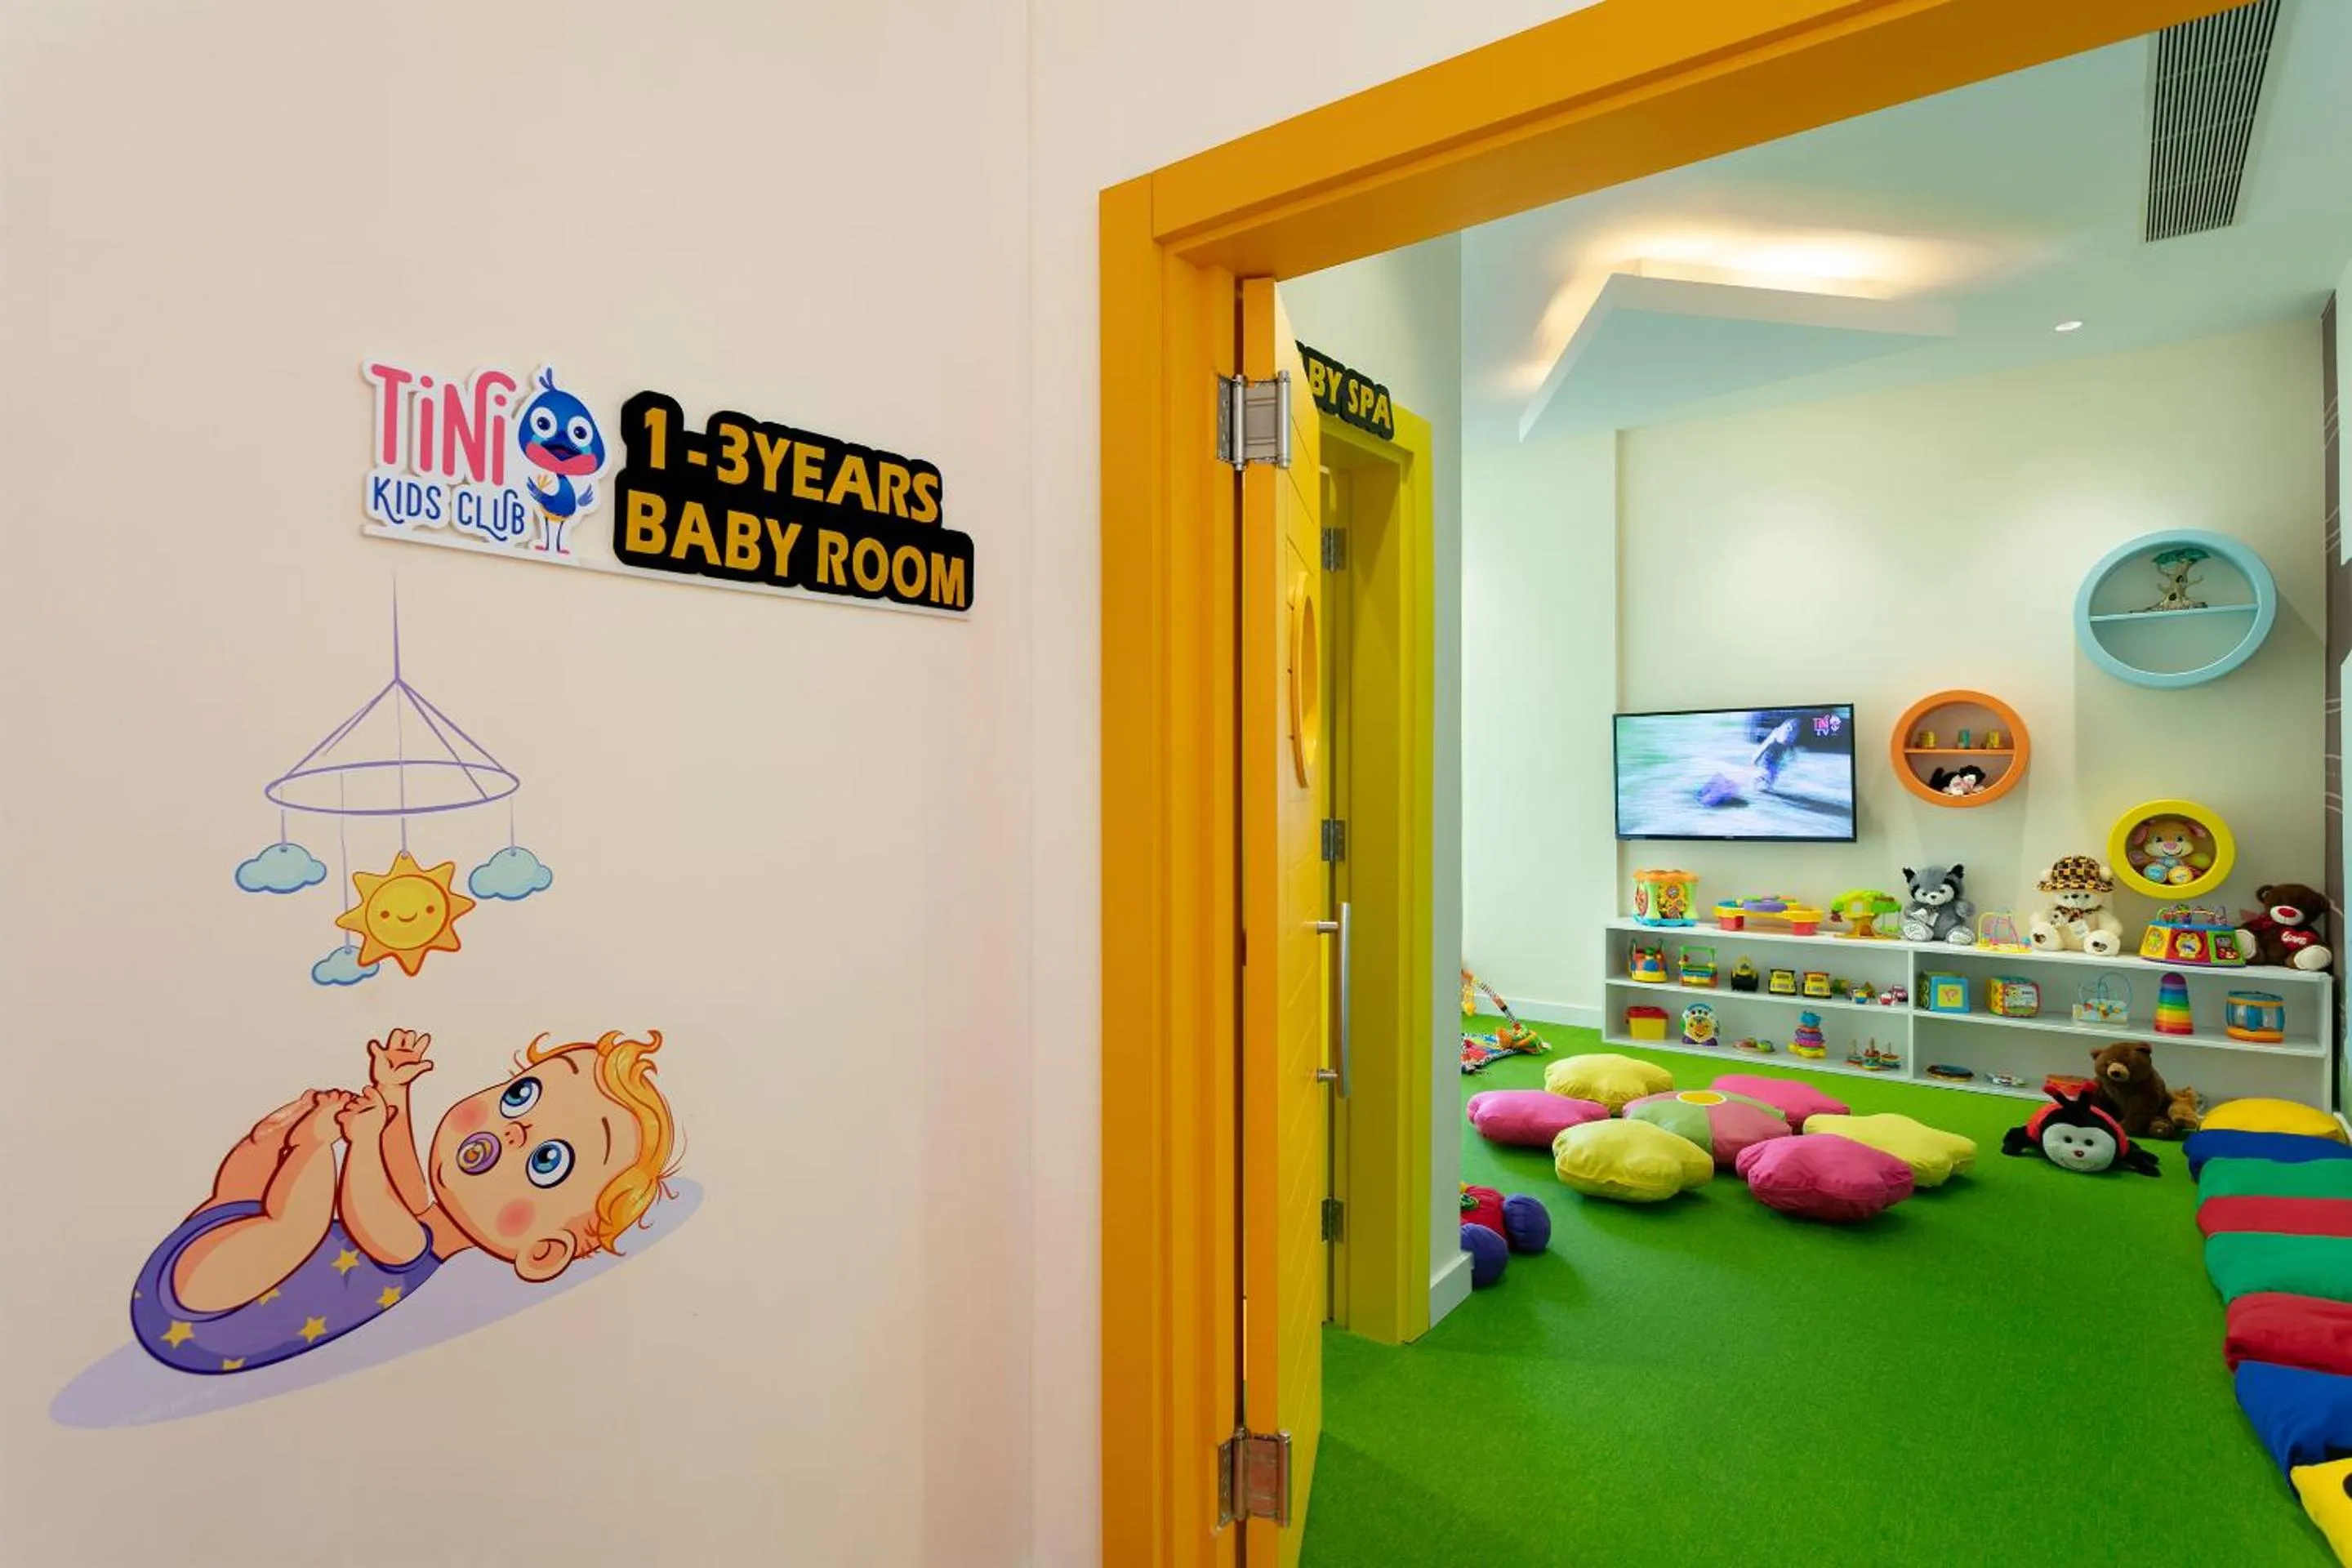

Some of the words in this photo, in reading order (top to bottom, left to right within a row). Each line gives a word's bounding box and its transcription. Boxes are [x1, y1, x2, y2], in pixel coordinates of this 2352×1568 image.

[1348, 379, 1391, 429] SPA
[373, 475, 442, 524] KIDS
[458, 488, 524, 541] CLUB
[626, 489, 803, 577] BABY
[817, 528, 965, 608] ROOM
